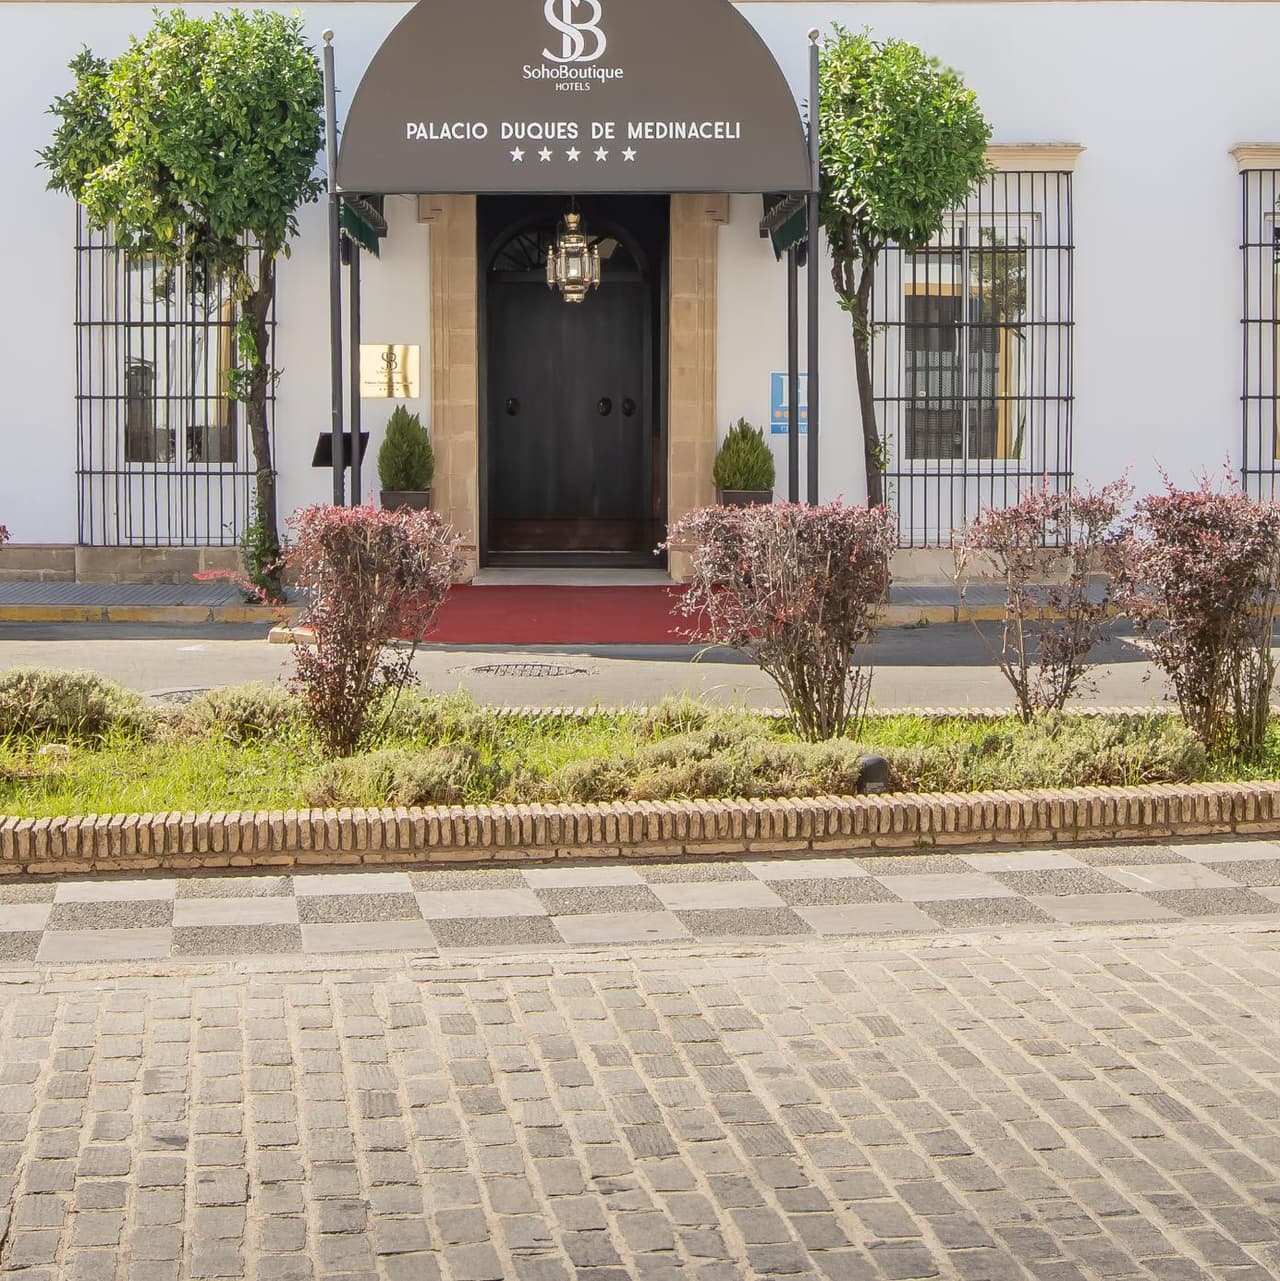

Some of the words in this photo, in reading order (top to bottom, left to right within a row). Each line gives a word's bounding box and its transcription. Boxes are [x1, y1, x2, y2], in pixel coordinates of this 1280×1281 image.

[522, 63, 624, 83] SohoBoutique
[555, 81, 591, 92] HOTELS
[406, 121, 488, 140] PALACIO
[501, 121, 579, 140] DUQUES
[591, 121, 616, 140] DE
[627, 121, 741, 140] MEDINACELI
